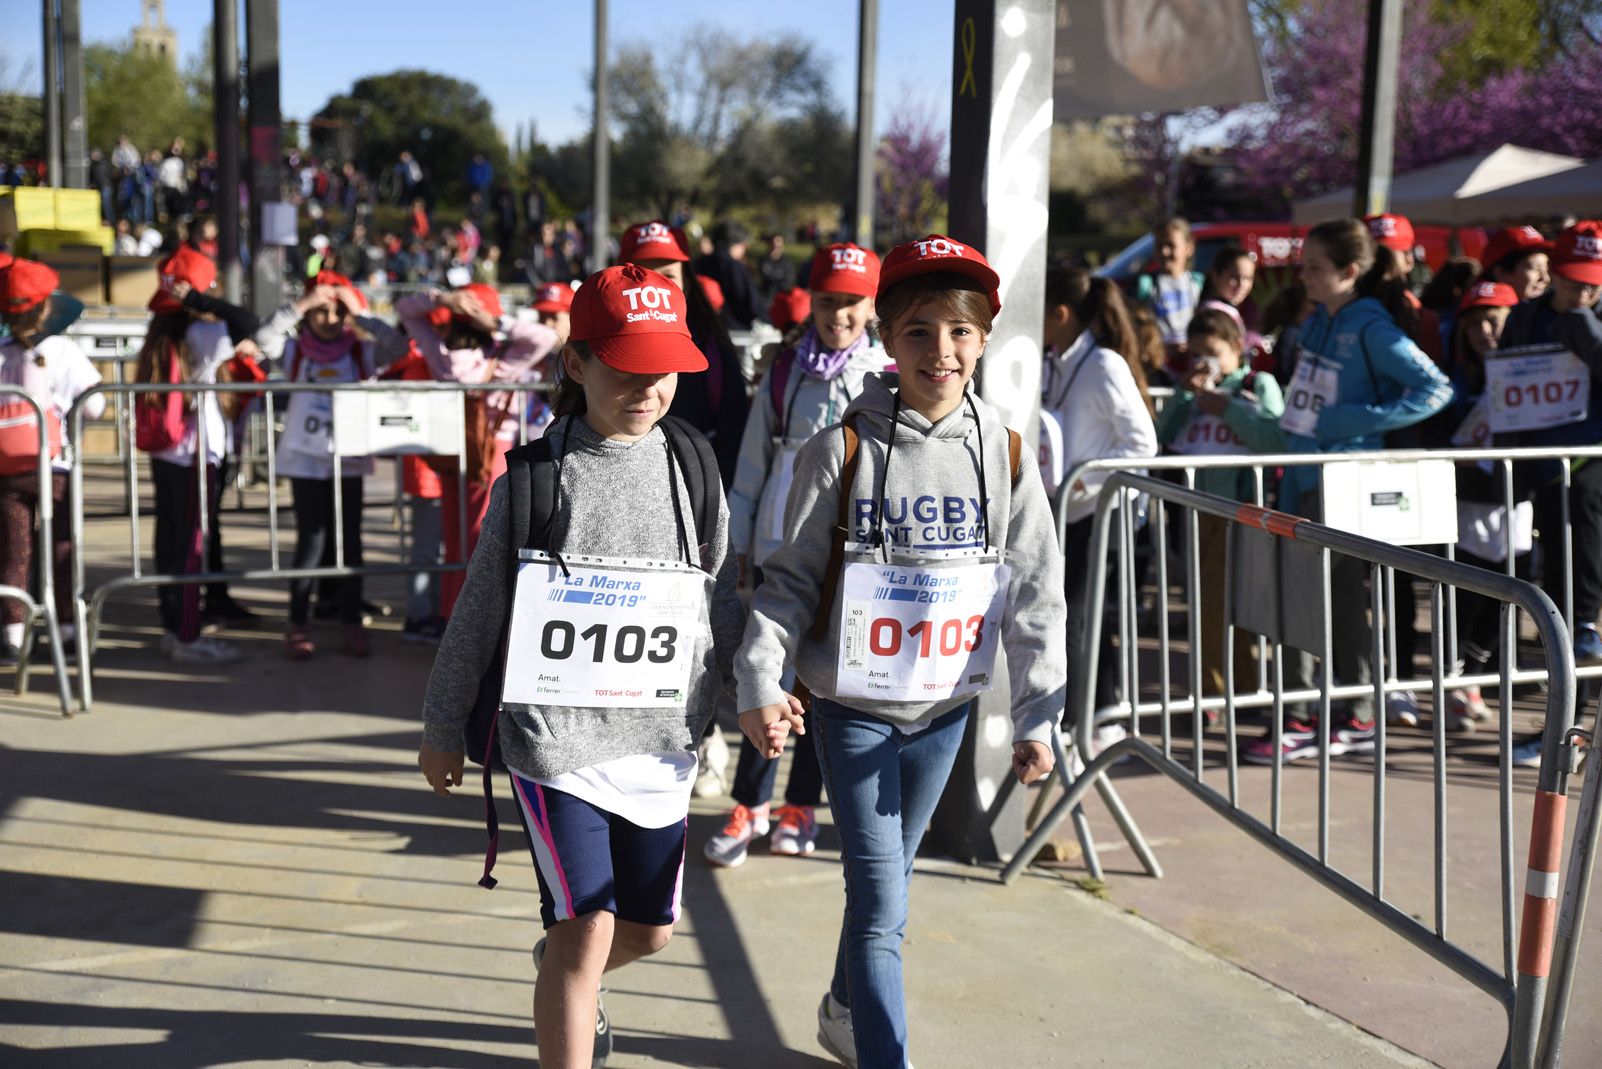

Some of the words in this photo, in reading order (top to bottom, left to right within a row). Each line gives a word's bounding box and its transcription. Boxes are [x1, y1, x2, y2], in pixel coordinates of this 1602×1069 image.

[831, 248, 868, 265] TOT
[914, 239, 964, 257] TOT
[622, 285, 671, 310] TOT
[626, 311, 650, 323] Sant
[653, 310, 678, 324] Cugat
[1504, 379, 1581, 408] 0107
[855, 495, 991, 527] RUGBY
[922, 525, 987, 543] CUGAT
[589, 575, 642, 591] Marxa
[913, 573, 958, 587] Marxa
[540, 619, 678, 664] 0103
[869, 614, 985, 658] 0103
[537, 673, 561, 683] Amat.
[868, 670, 891, 679] Amat.
[543, 686, 561, 694] ferrer
[594, 689, 609, 697] TOT
[609, 689, 623, 697] Sant
